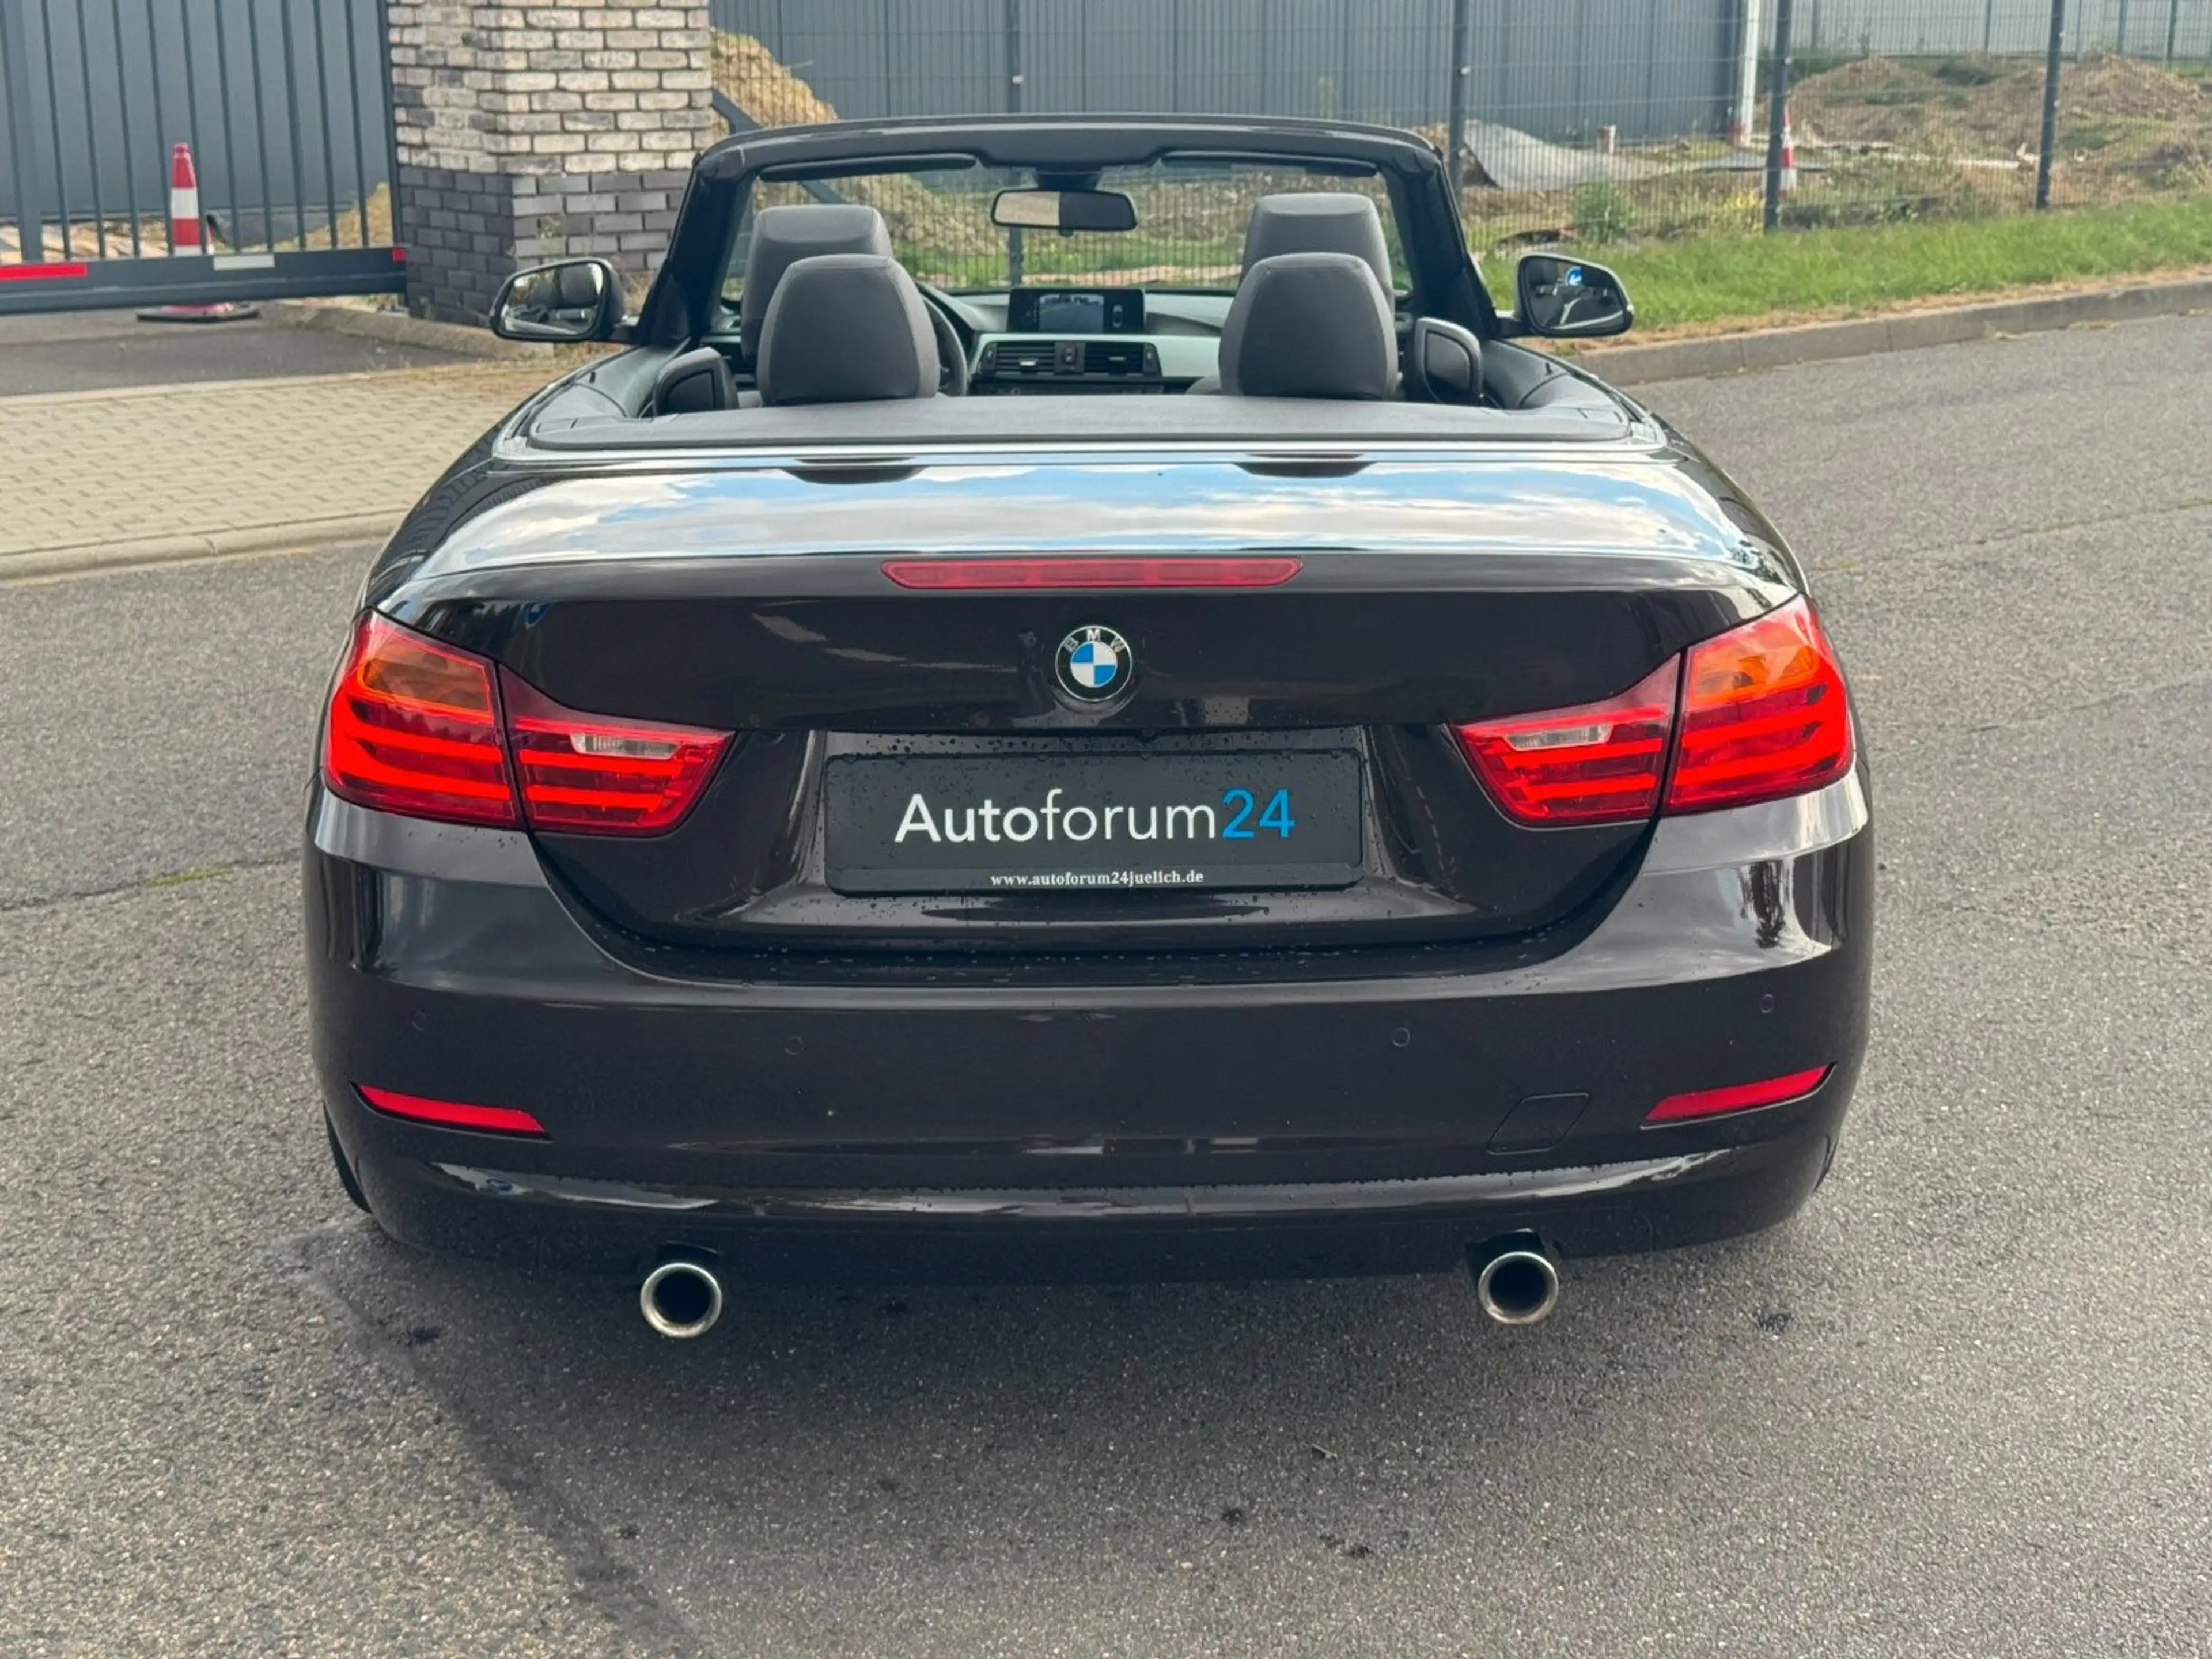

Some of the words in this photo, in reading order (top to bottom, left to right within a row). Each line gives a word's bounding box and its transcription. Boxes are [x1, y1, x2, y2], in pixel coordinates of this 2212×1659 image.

[1063, 628, 1126, 653] BMW
[894, 788, 1295, 843] Autoforum24
[990, 869, 1205, 888] www.autoforum24juelich.de
